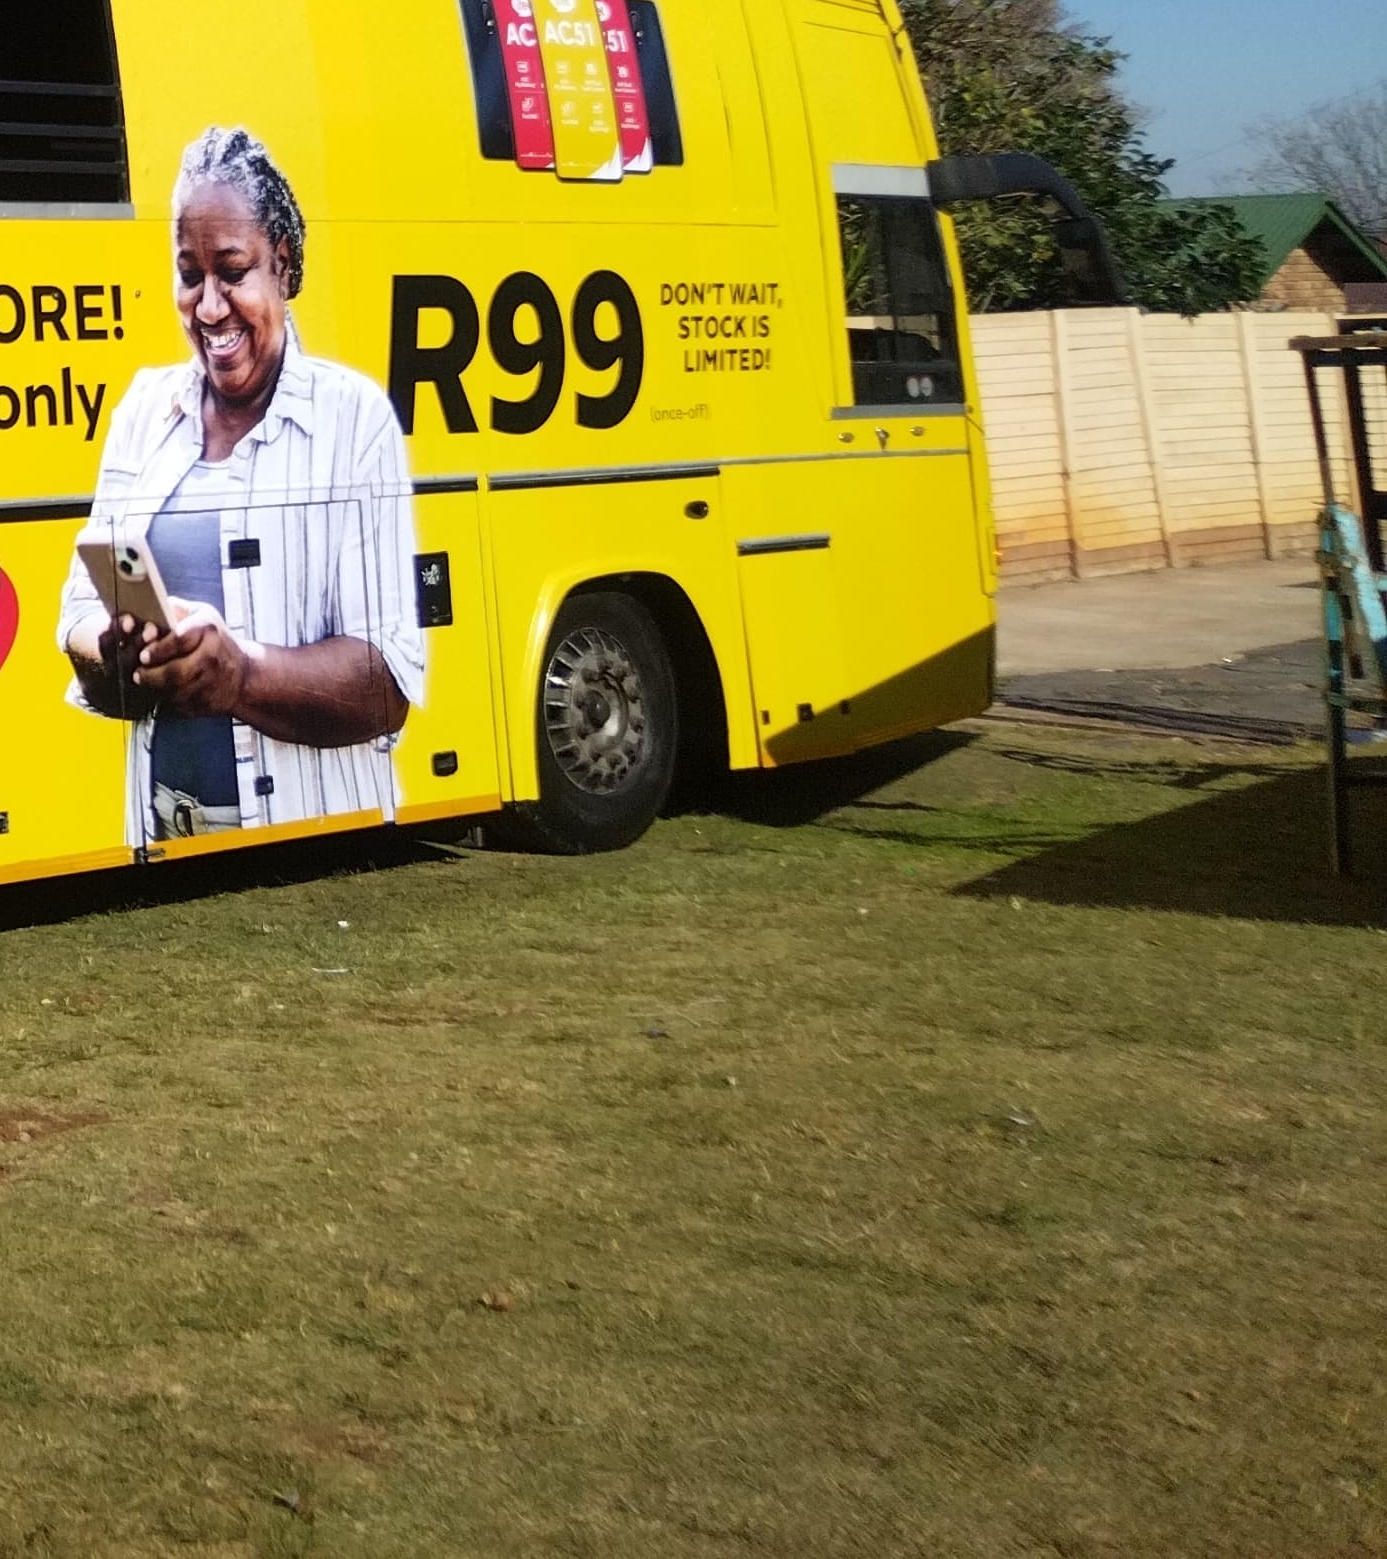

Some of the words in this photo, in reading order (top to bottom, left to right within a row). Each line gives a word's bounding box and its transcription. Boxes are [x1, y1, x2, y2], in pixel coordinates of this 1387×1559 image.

[545, 20, 594, 46] AC51
[602, 29, 628, 52] 51
[660, 282, 726, 307] DON'T
[728, 282, 783, 308] WAIT,
[678, 315, 747, 340] STOCK
[752, 314, 770, 338] IS
[386, 269, 645, 436] R99
[683, 348, 772, 372] LIMITED!
[650, 403, 710, 423] (once-off)
